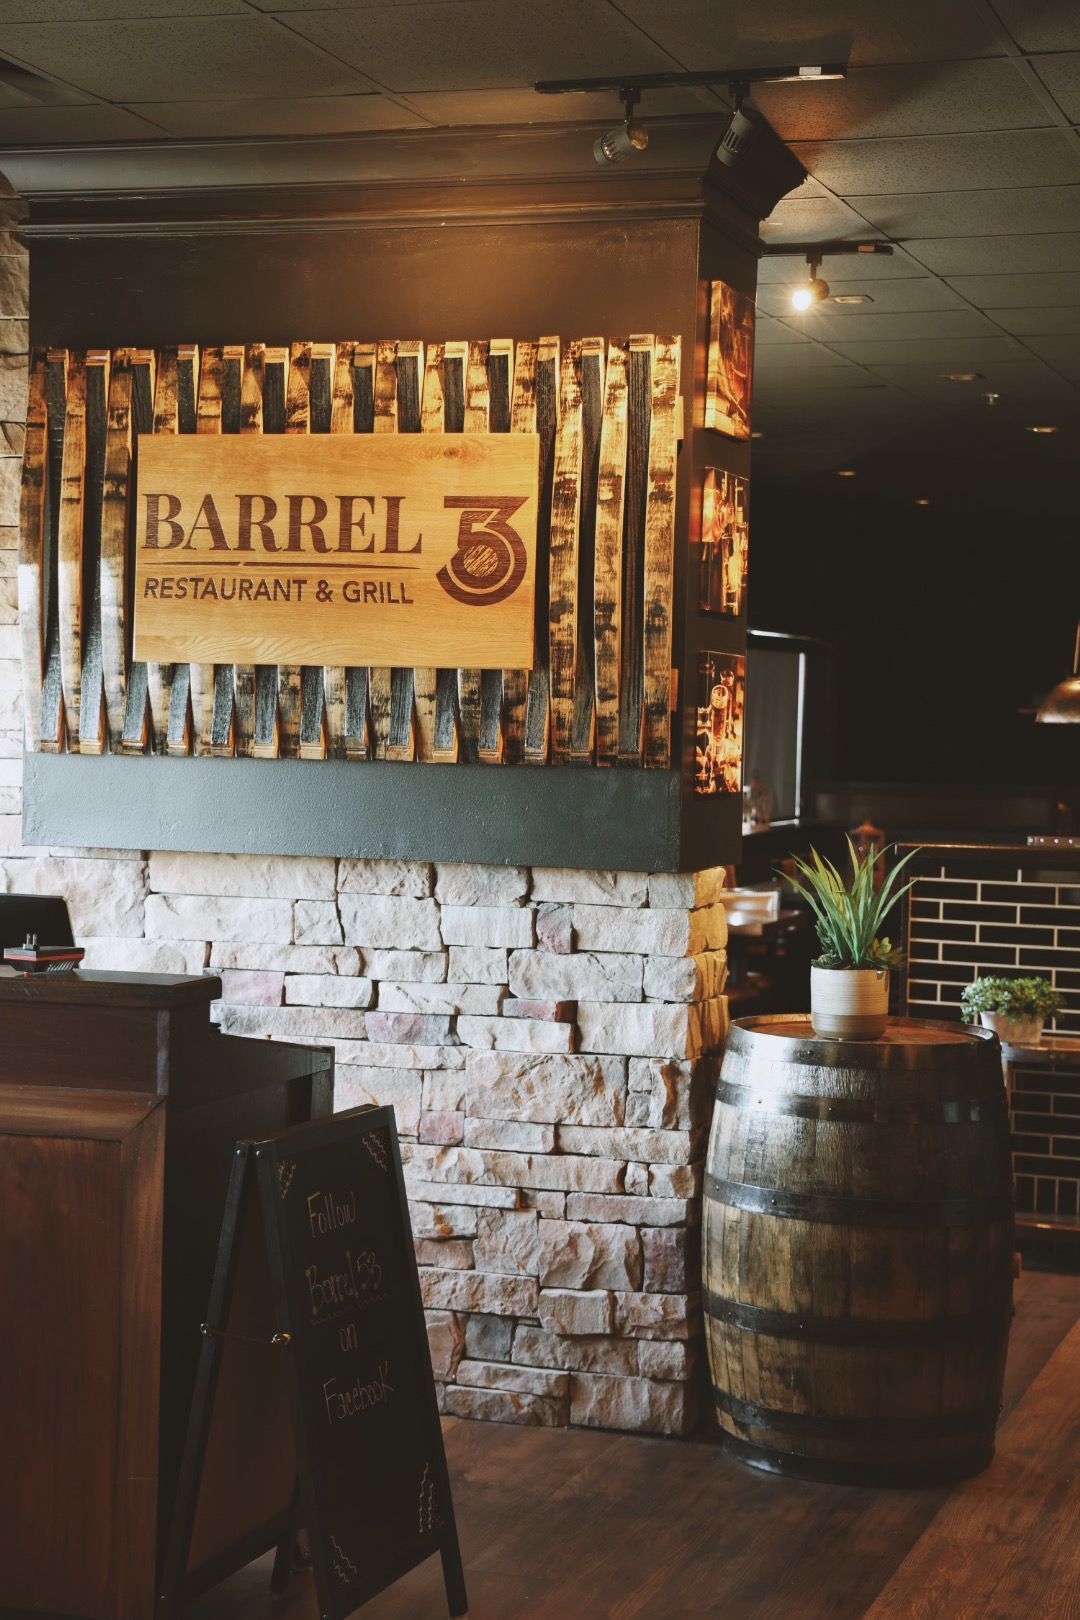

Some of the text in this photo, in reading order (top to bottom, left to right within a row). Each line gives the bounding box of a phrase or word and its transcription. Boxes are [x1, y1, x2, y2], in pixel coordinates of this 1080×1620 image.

[141, 493, 422, 553] BARREL
[144, 577, 415, 604] RESTAURANT & GRILL
[306, 1190, 356, 1238] Follow
[337, 1323, 358, 1352] on
